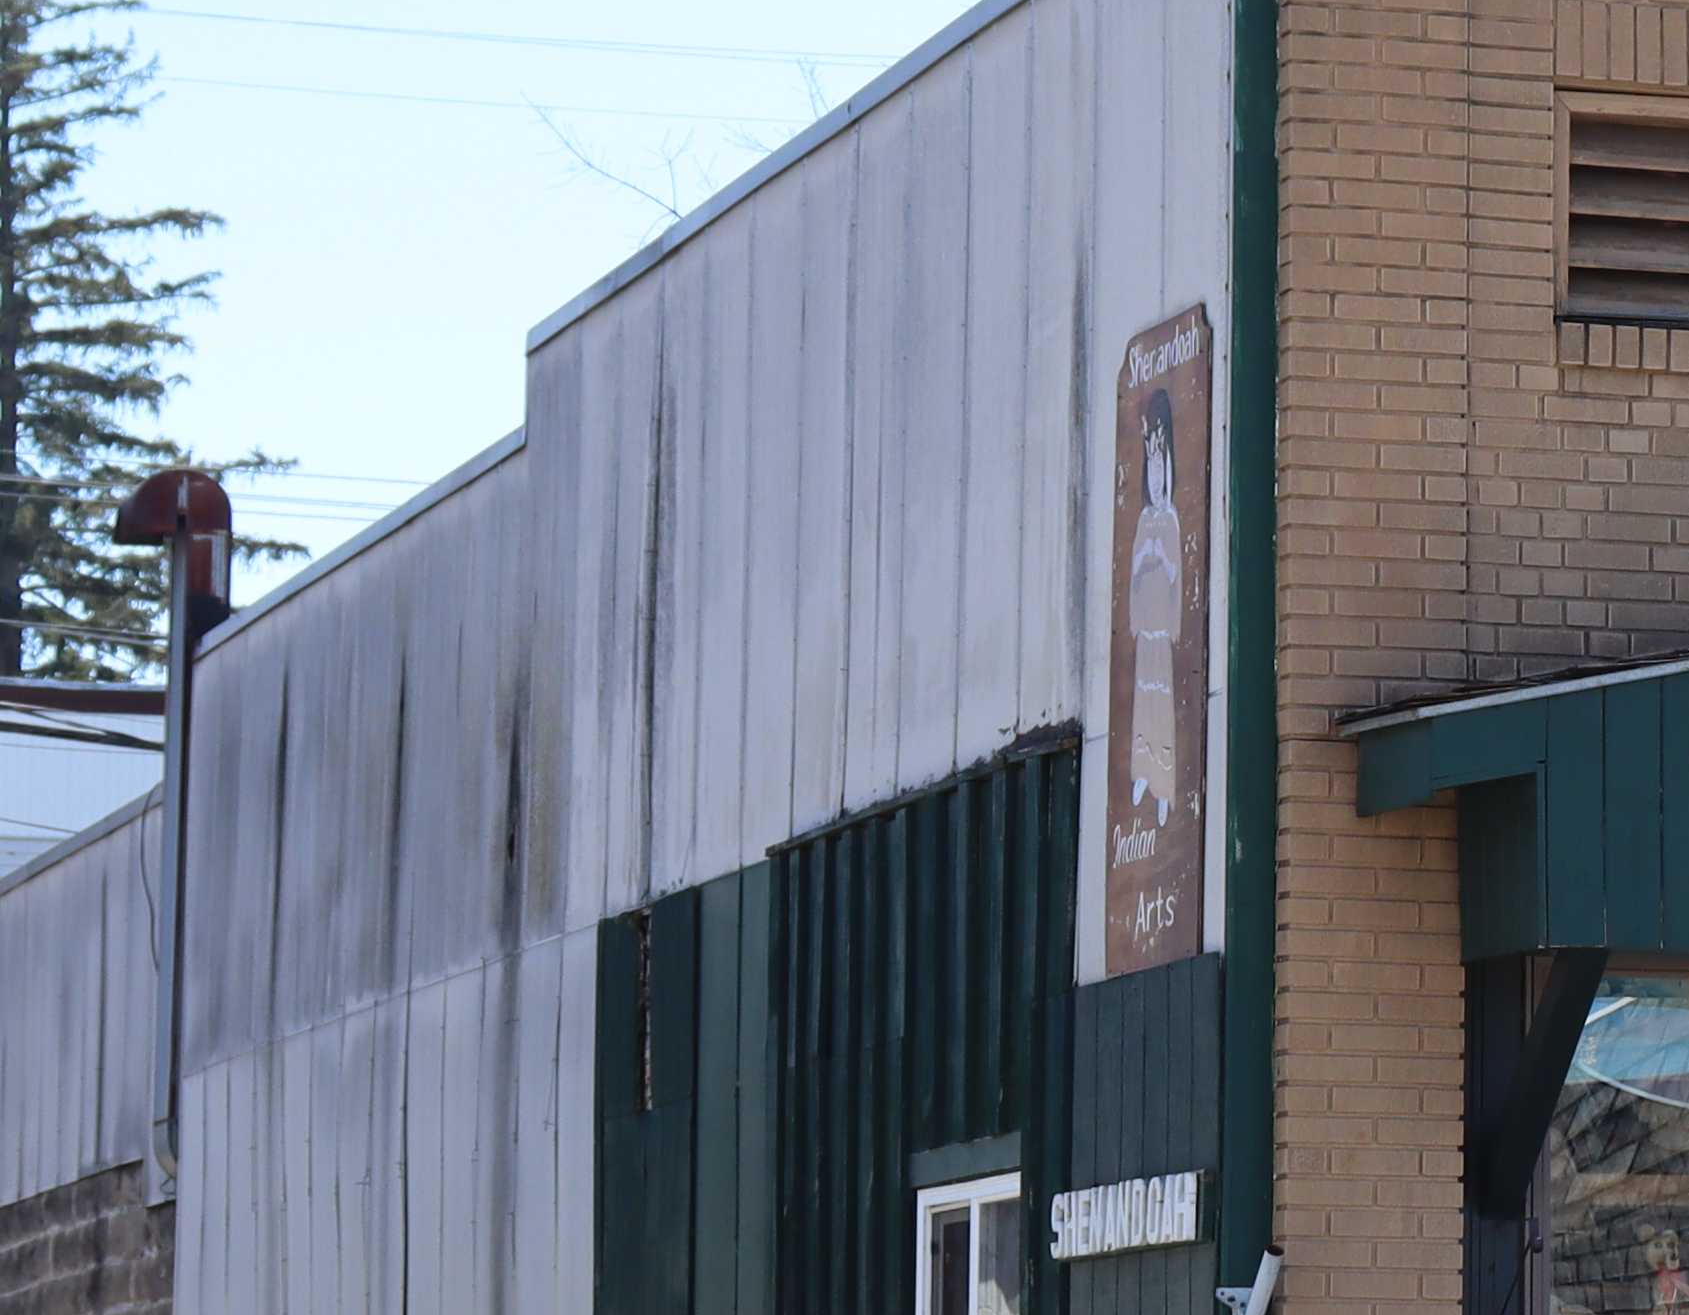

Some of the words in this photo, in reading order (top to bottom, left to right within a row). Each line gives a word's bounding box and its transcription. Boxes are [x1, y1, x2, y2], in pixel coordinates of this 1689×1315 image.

[1113, 816, 1156, 869] Indian
[1134, 886, 1176, 942] Arts
[1050, 1171, 1198, 1260] SHENANDOAH
